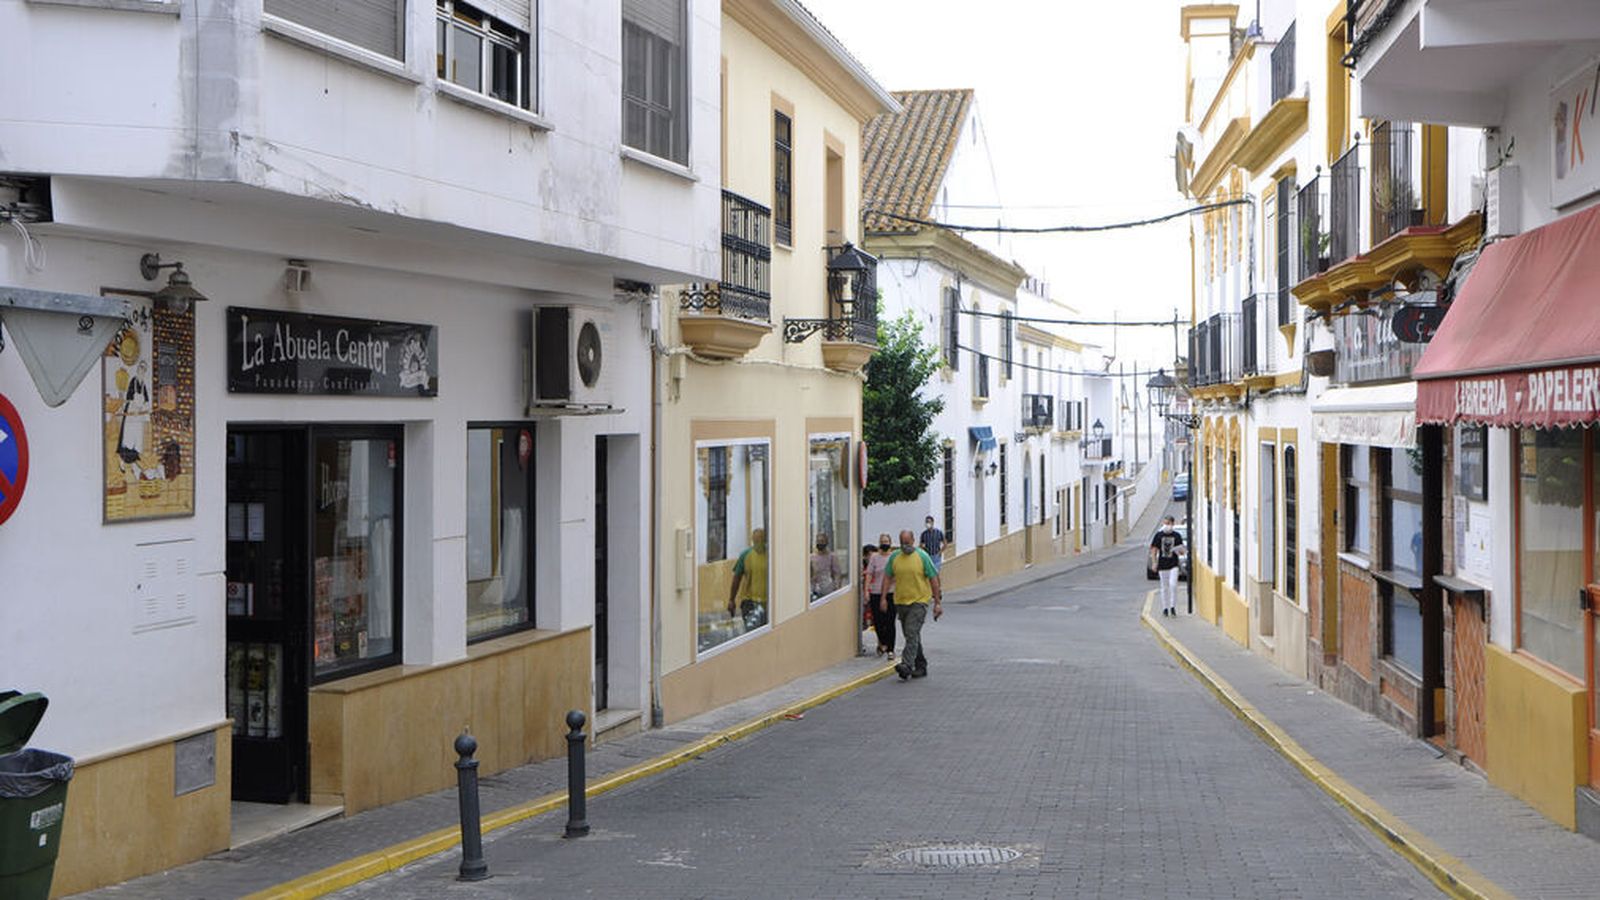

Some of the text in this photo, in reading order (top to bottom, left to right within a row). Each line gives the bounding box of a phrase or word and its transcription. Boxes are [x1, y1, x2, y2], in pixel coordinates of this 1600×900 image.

[241, 314, 390, 375] La Abuela Center
[1455, 378, 1507, 416] LIBRERIA
